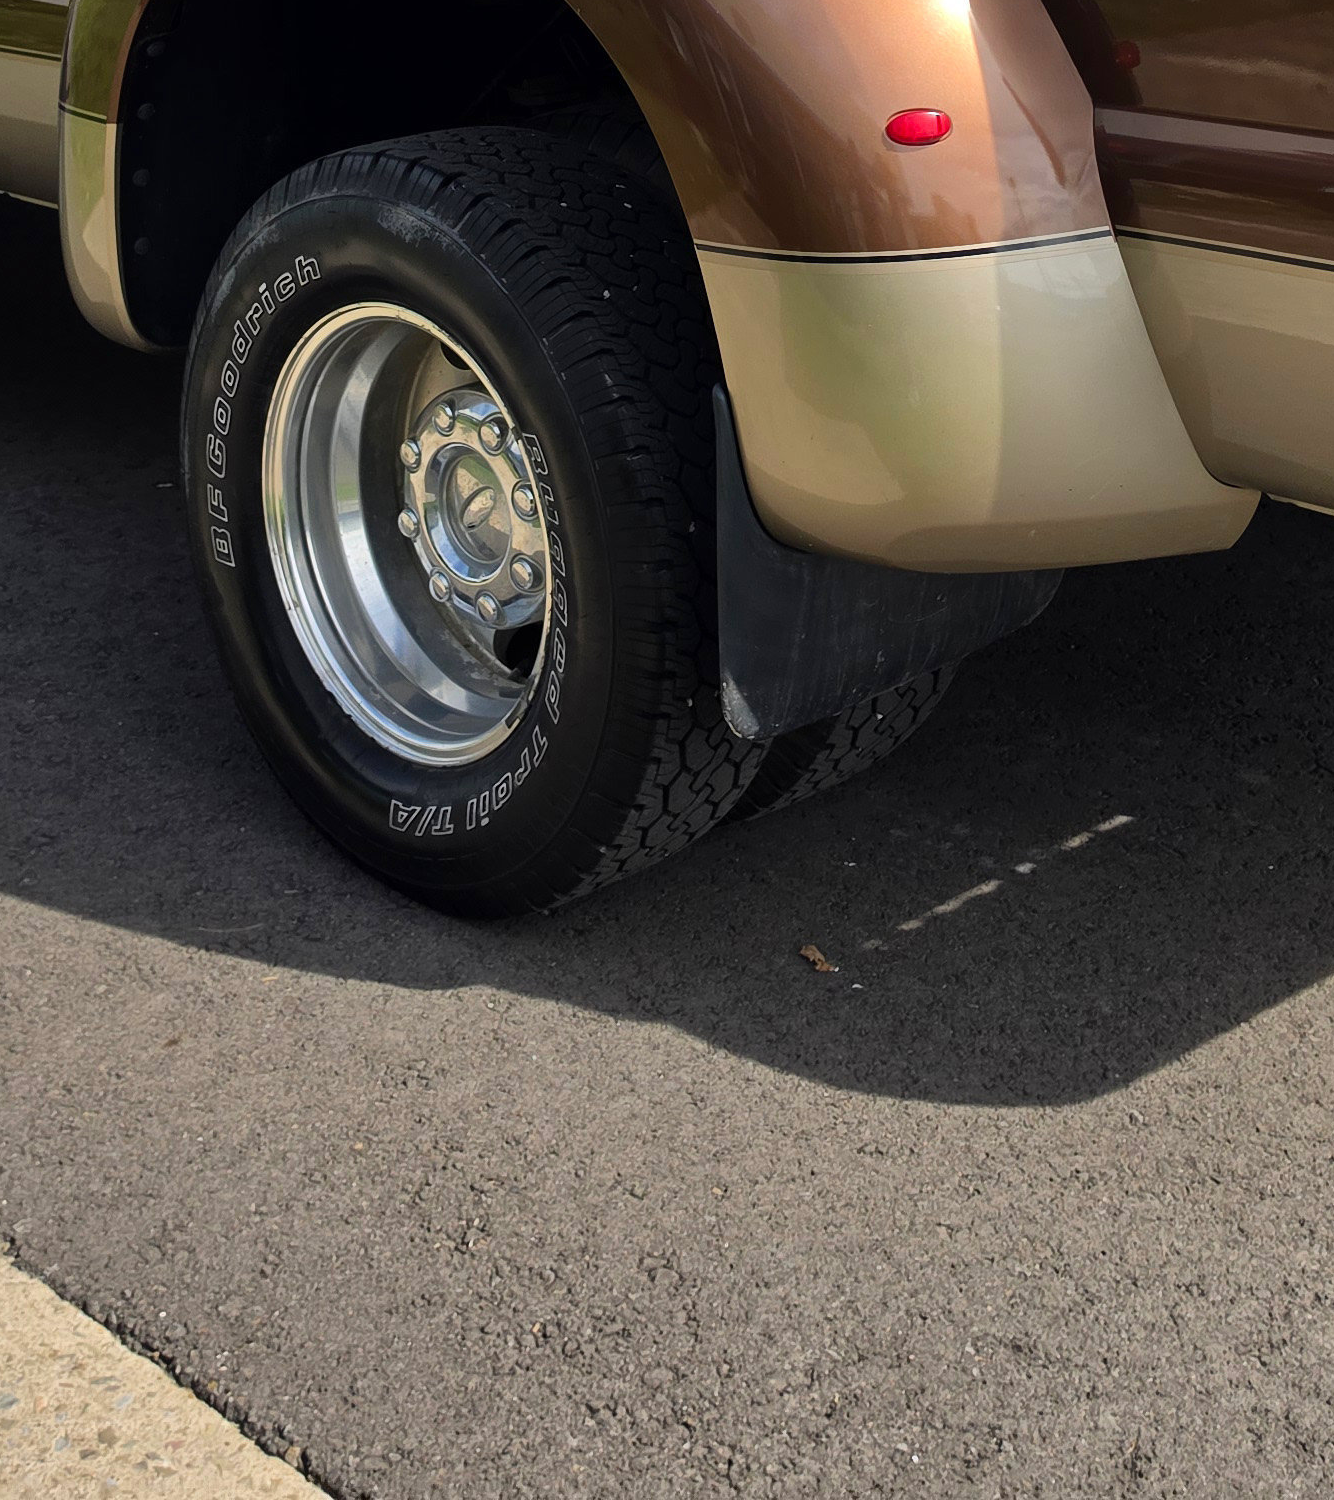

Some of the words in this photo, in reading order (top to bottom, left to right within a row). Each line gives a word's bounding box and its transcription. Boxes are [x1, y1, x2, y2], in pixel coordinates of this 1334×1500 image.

[522, 432, 569, 726] Rugged
[389, 799, 455, 837] T/A
[466, 725, 549, 831] Trail
